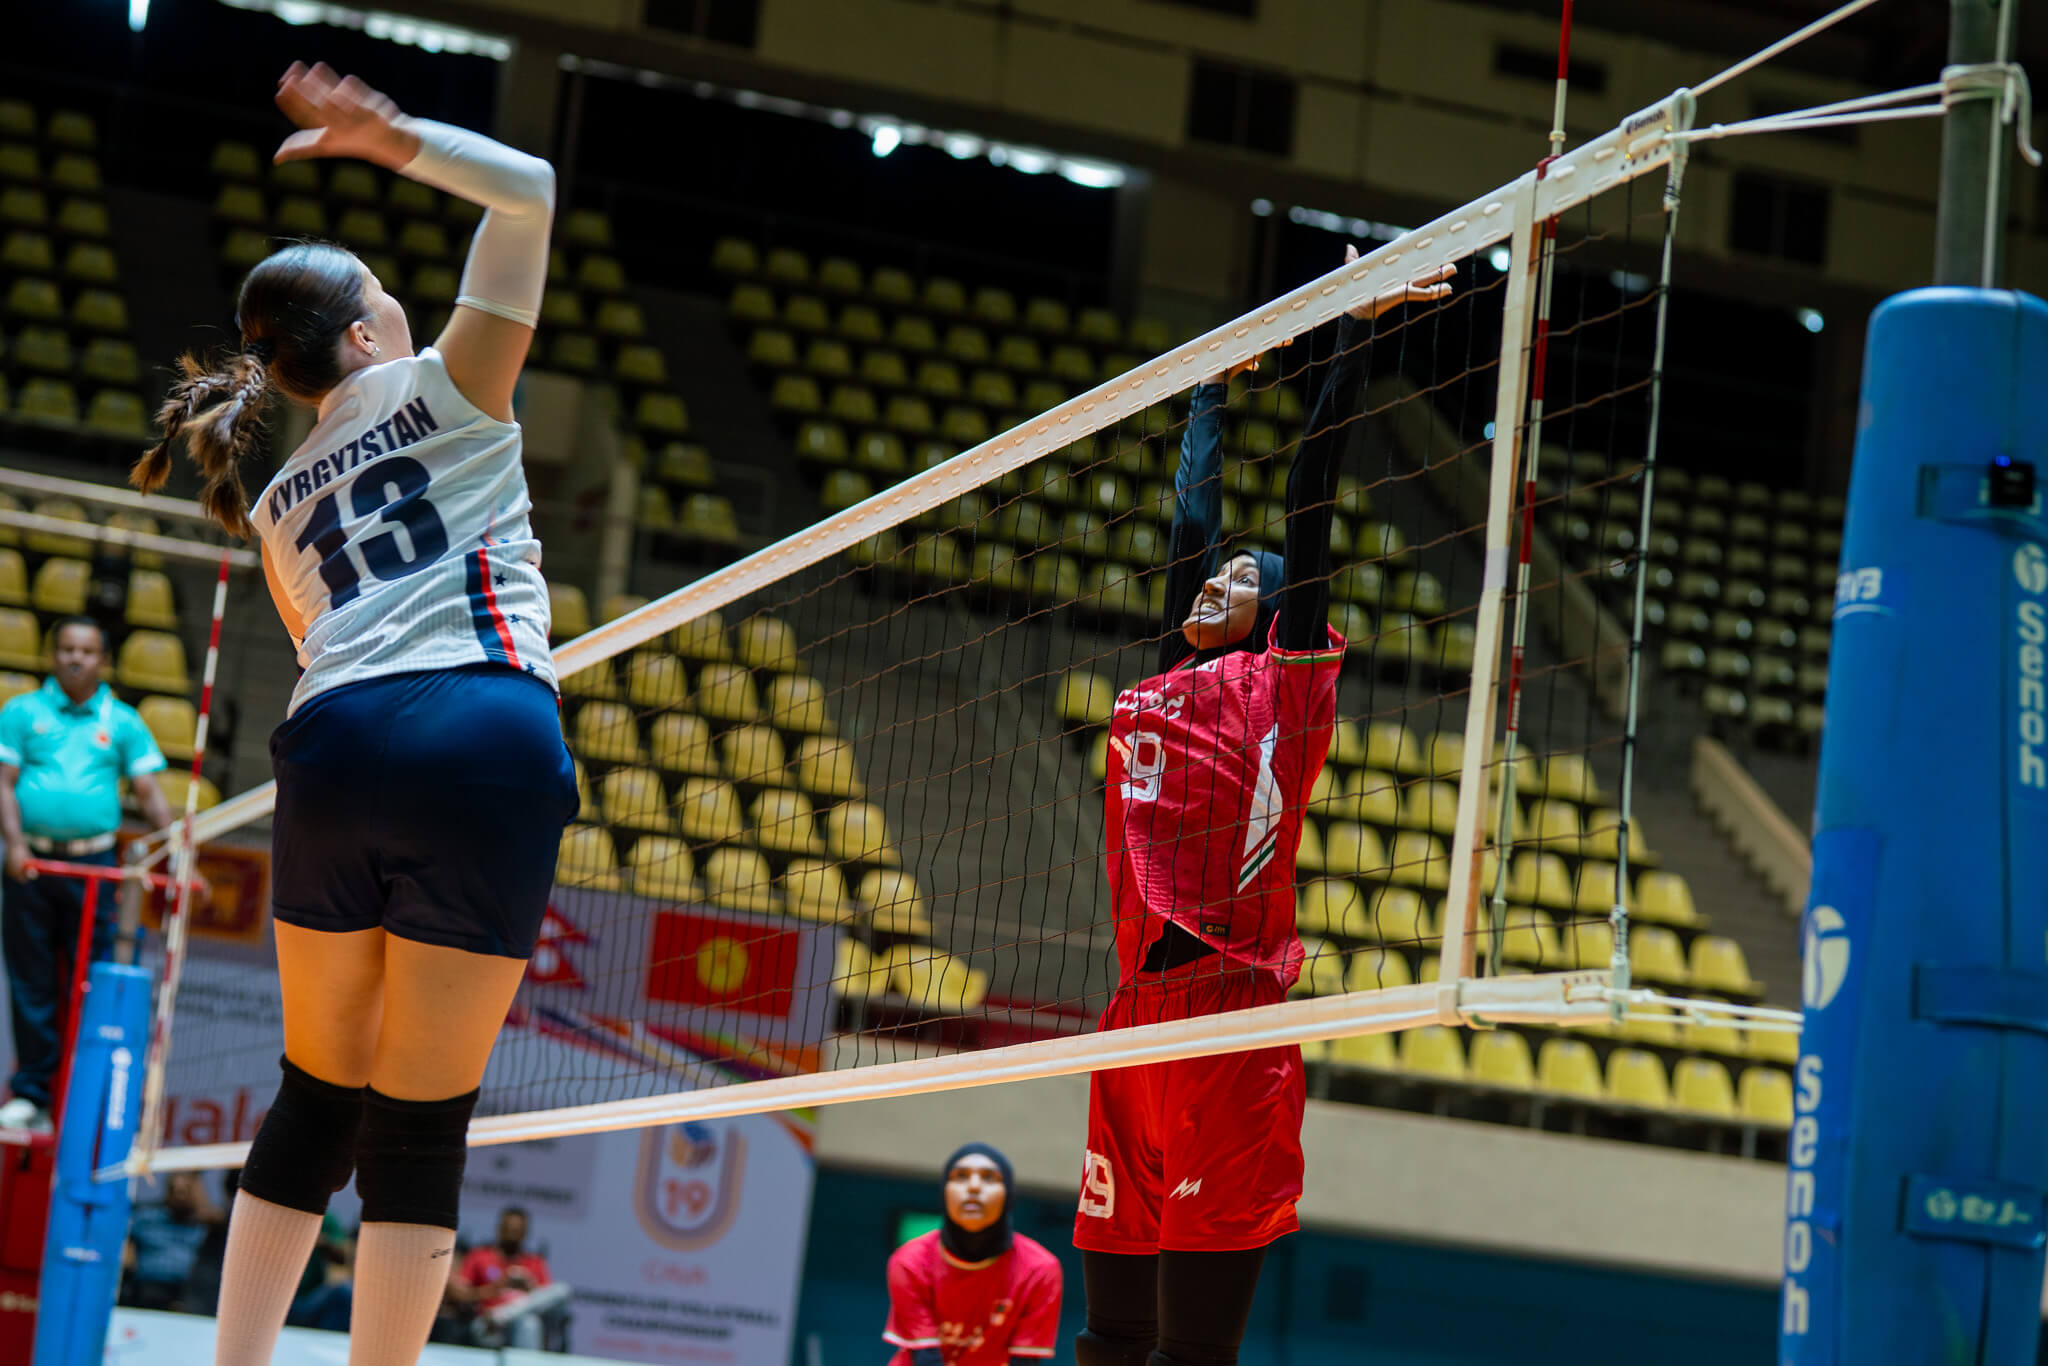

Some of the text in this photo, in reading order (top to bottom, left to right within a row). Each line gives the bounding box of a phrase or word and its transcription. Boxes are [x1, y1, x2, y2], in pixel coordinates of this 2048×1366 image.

[269, 396, 438, 526] KYRGYZSTAN
[295, 456, 449, 610] 13
[664, 1179, 712, 1216] 19
